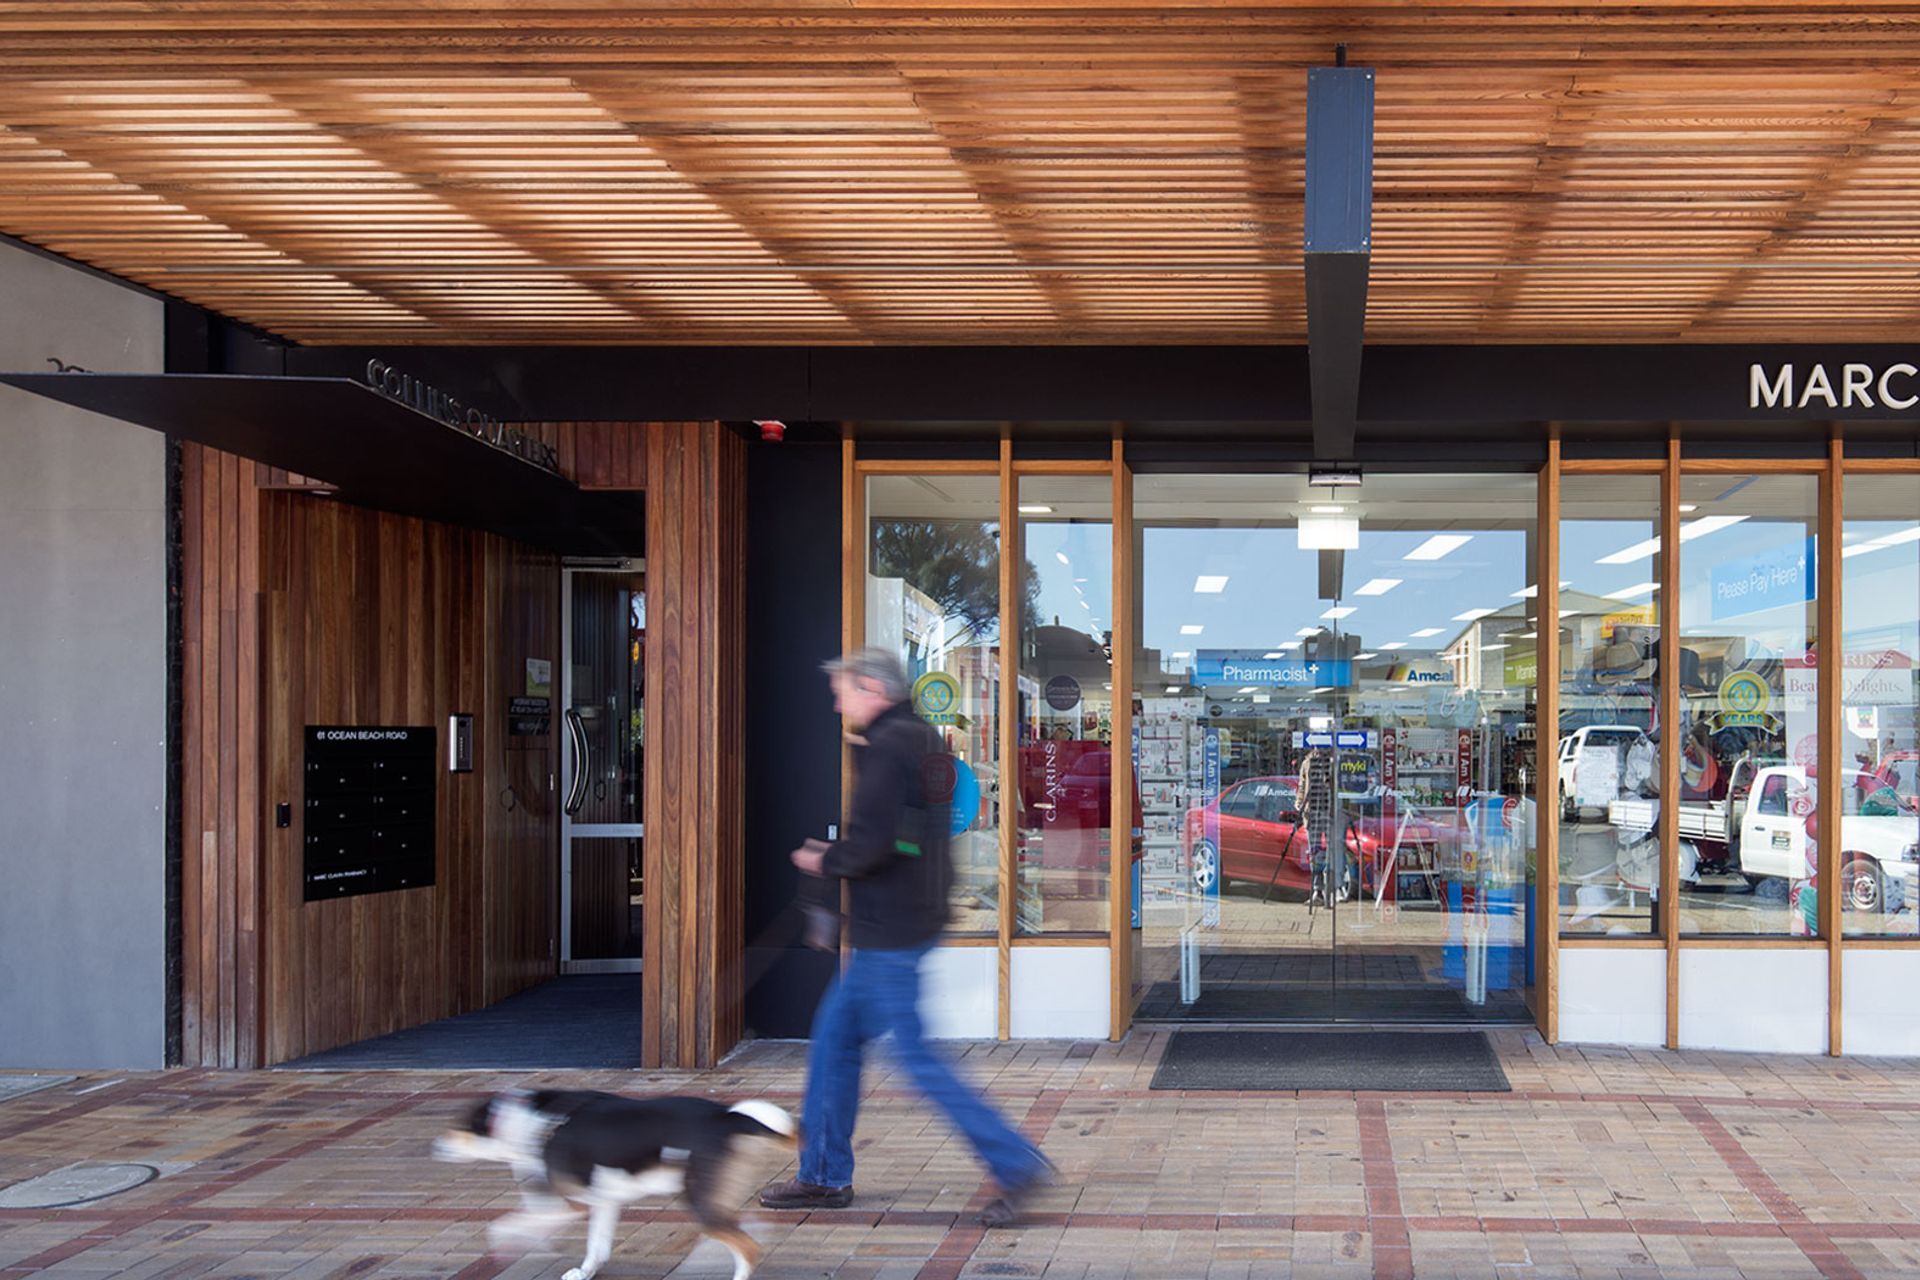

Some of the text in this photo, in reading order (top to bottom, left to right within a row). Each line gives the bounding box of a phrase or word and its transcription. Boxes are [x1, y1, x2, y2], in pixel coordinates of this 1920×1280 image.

[366, 357, 462, 426] COLLINS
[1750, 363, 1919, 409] MARC
[1717, 567, 1797, 599] Please Pay Here
[1802, 653, 1894, 666] CRINS
[1223, 666, 1308, 681] Pharmacist
[1407, 669, 1454, 682] Amcal
[1724, 713, 1763, 725] YEARS
[316, 731, 408, 740] 61 OCEAN BEACH ROAD
[1340, 760, 1367, 774] myki
[1046, 741, 1057, 822] CLARINS
[1267, 788, 1298, 796] Amcal
